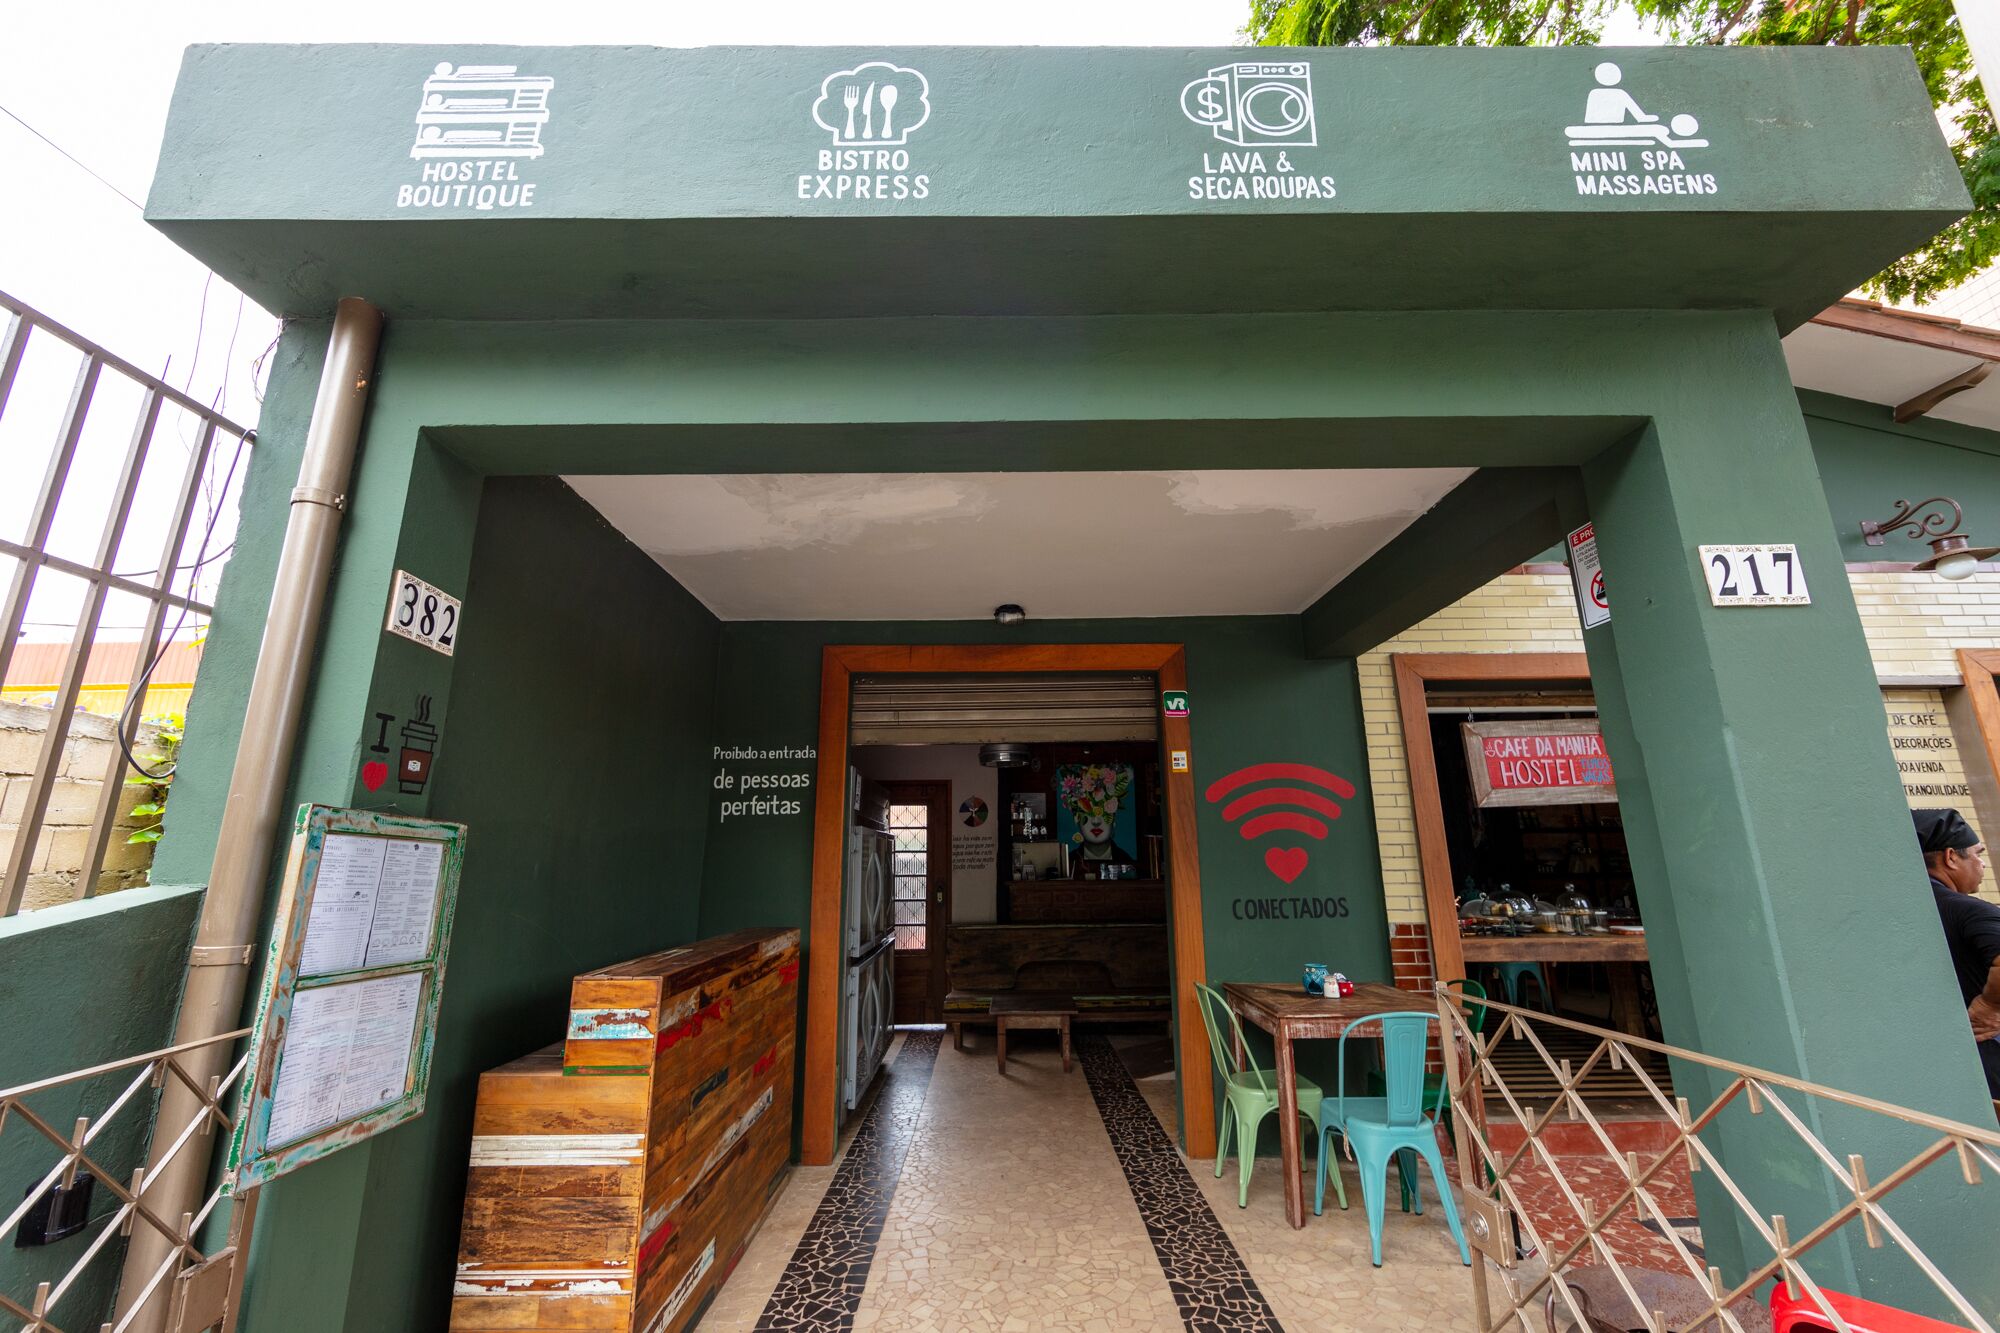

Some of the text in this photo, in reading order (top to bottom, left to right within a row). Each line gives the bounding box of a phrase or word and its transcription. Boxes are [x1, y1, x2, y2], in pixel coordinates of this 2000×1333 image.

[422, 160, 519, 182] HOSTEL
[818, 149, 909, 171] BISTRO
[1203, 150, 1295, 174] LAVA &
[1570, 150, 1686, 172] MINI SPA
[396, 183, 537, 210] BOUTIQUE
[798, 174, 930, 200] EXPRESS
[1188, 175, 1337, 200] SECA ROUPAS
[1575, 173, 1718, 196] MASSAGENS
[1711, 553, 1792, 596] 217
[399, 583, 456, 646] 382
[1893, 709, 1937, 726] DE CAFÉ
[370, 712, 395, 753] I
[713, 745, 817, 760] Proibido a entrada
[1494, 734, 1602, 758] CAFÉ DA MANHÃ
[1500, 758, 1582, 787] HOSTEL
[1917, 762, 1946, 773] VENDA
[713, 767, 810, 795] de pessoas
[720, 795, 801, 823] perfeitas
[1232, 897, 1349, 920] CONECTADOS
